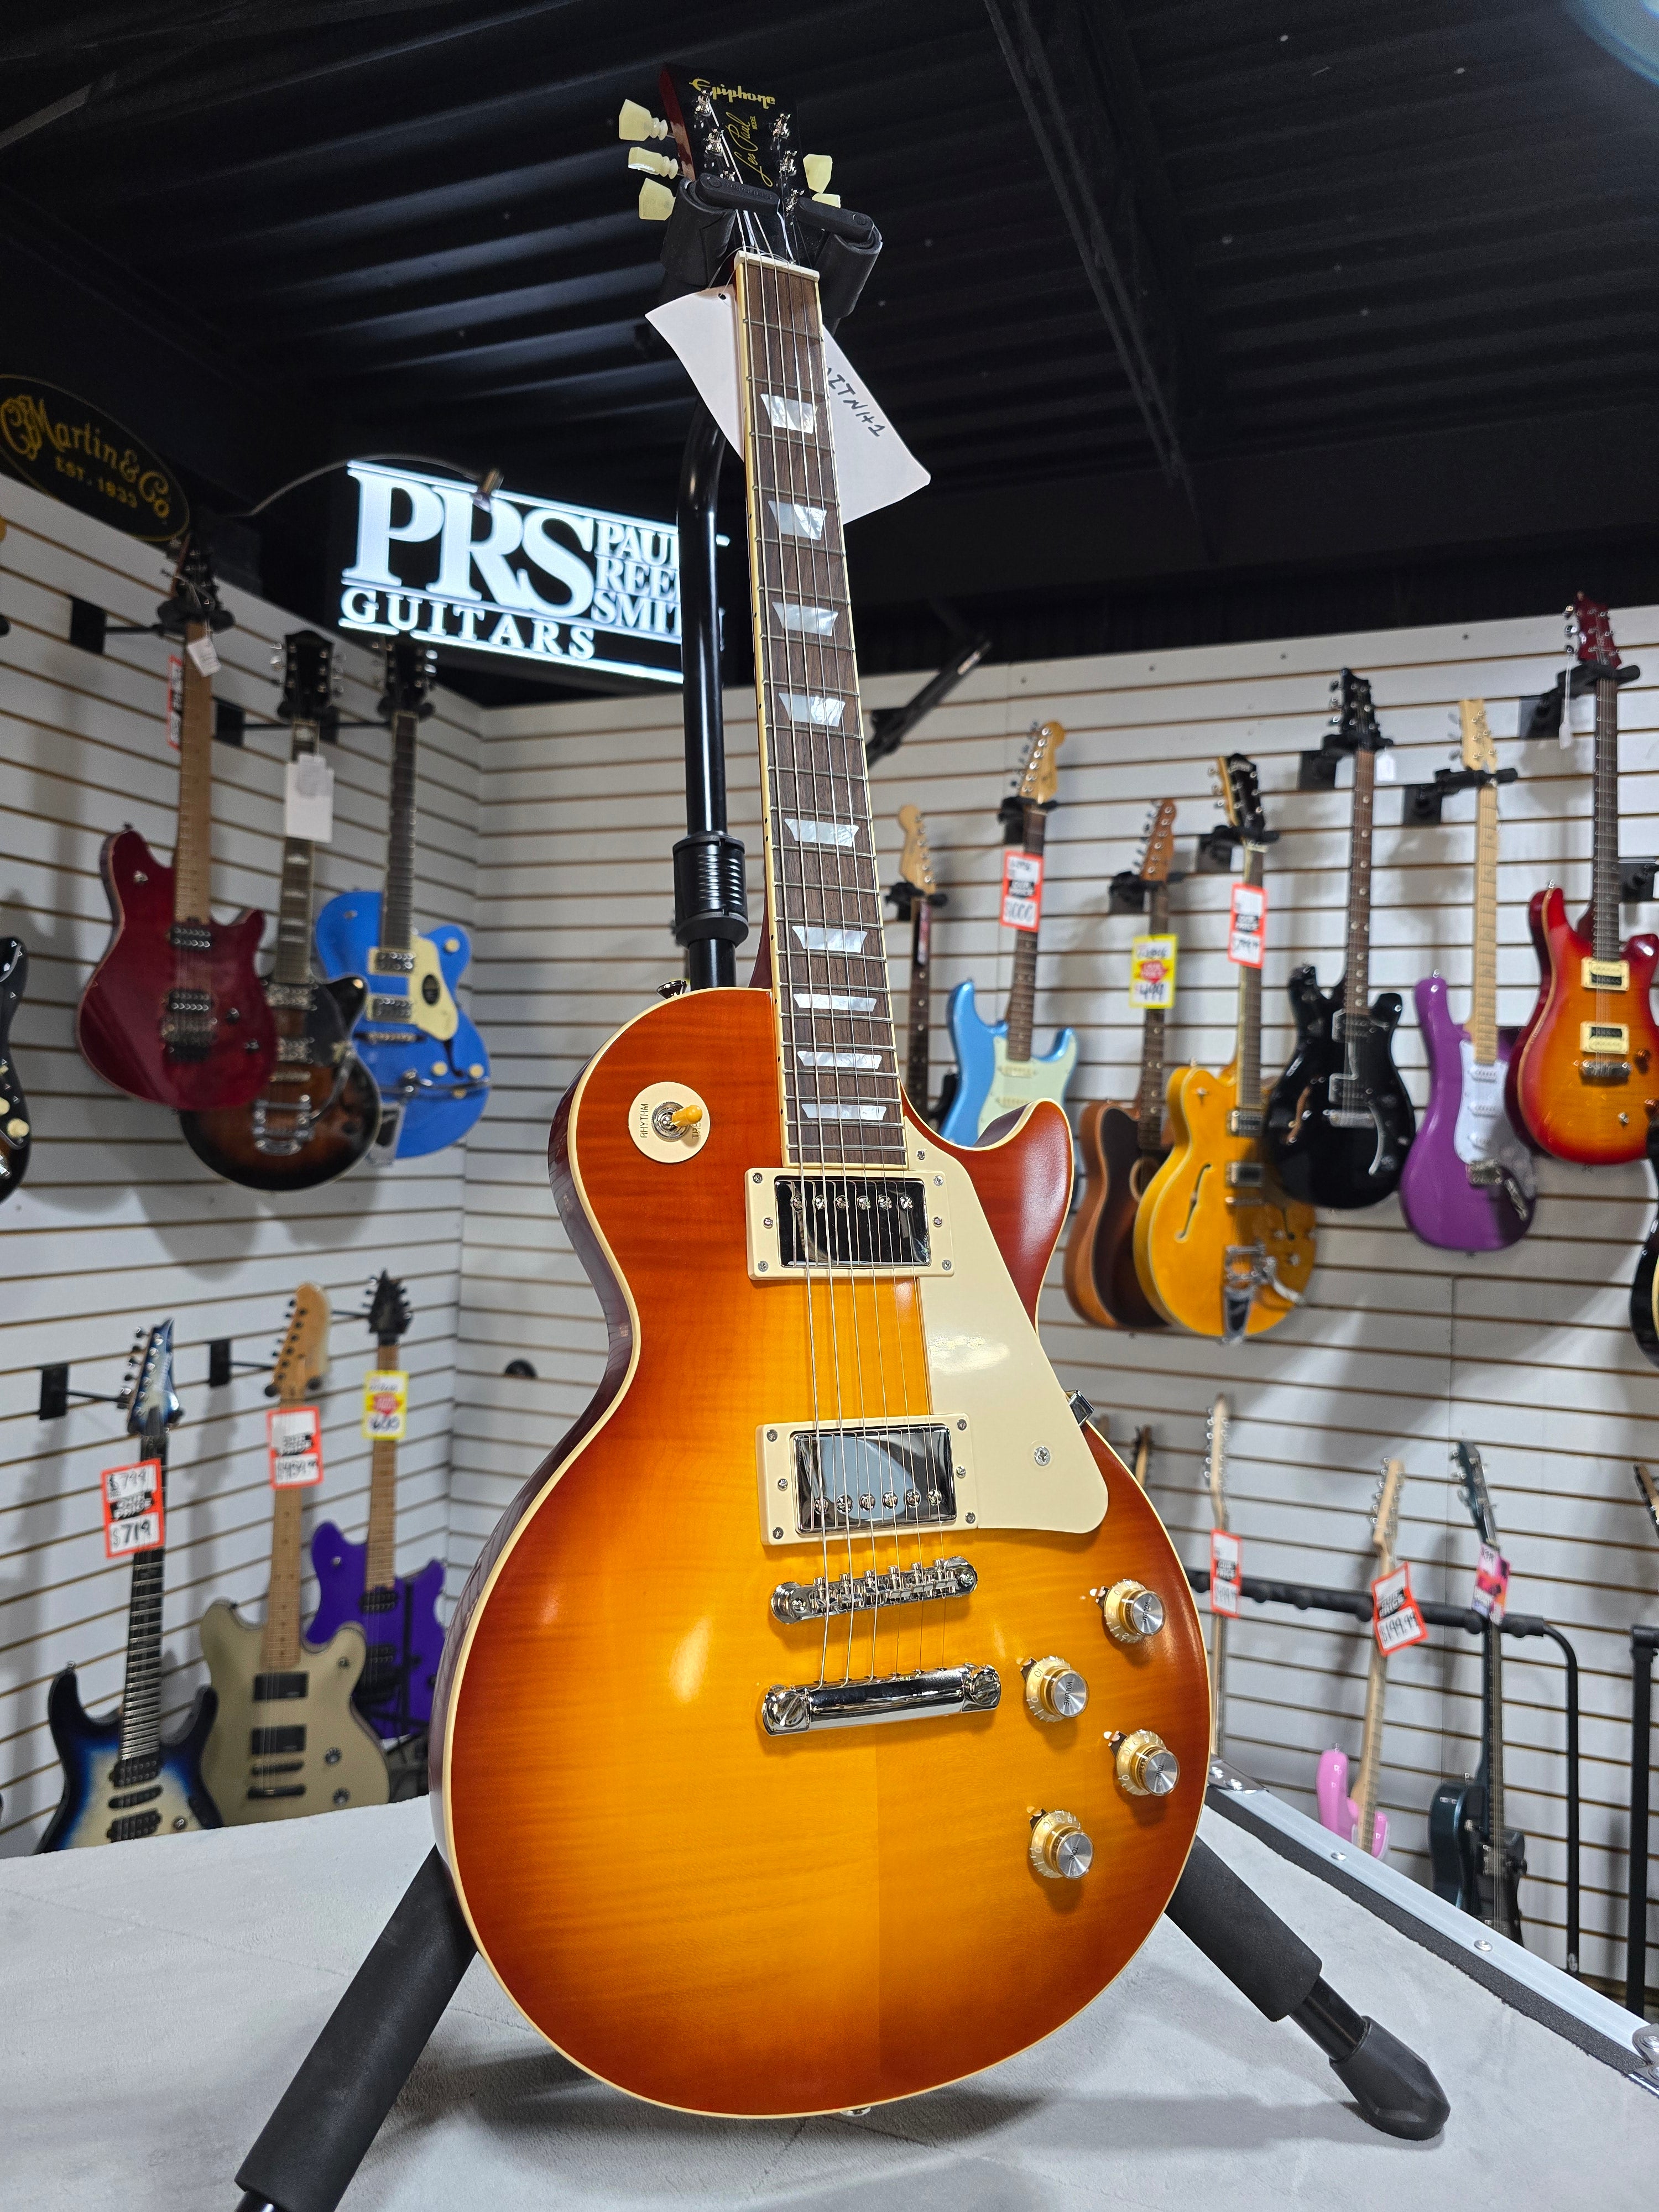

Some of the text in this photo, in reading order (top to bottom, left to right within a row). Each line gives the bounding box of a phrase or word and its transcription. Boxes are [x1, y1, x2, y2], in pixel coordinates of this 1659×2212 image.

[688, 78, 775, 109] Epiphone
[724, 112, 758, 152] Paul
[342, 468, 595, 617] PRS
[594, 553, 681, 602] REE
[341, 586, 595, 660] GUITARS
[640, 1103, 649, 1138] RHYTHM
[113, 1498, 153, 1521] PRICE
[1141, 1602, 1151, 1625] VOLUME
[1379, 1594, 1406, 1619] PRICE
[1064, 1682, 1073, 1707] VOLUME
[1155, 1765, 1165, 1780] TONE
[1069, 1846, 1079, 1862] TONE
